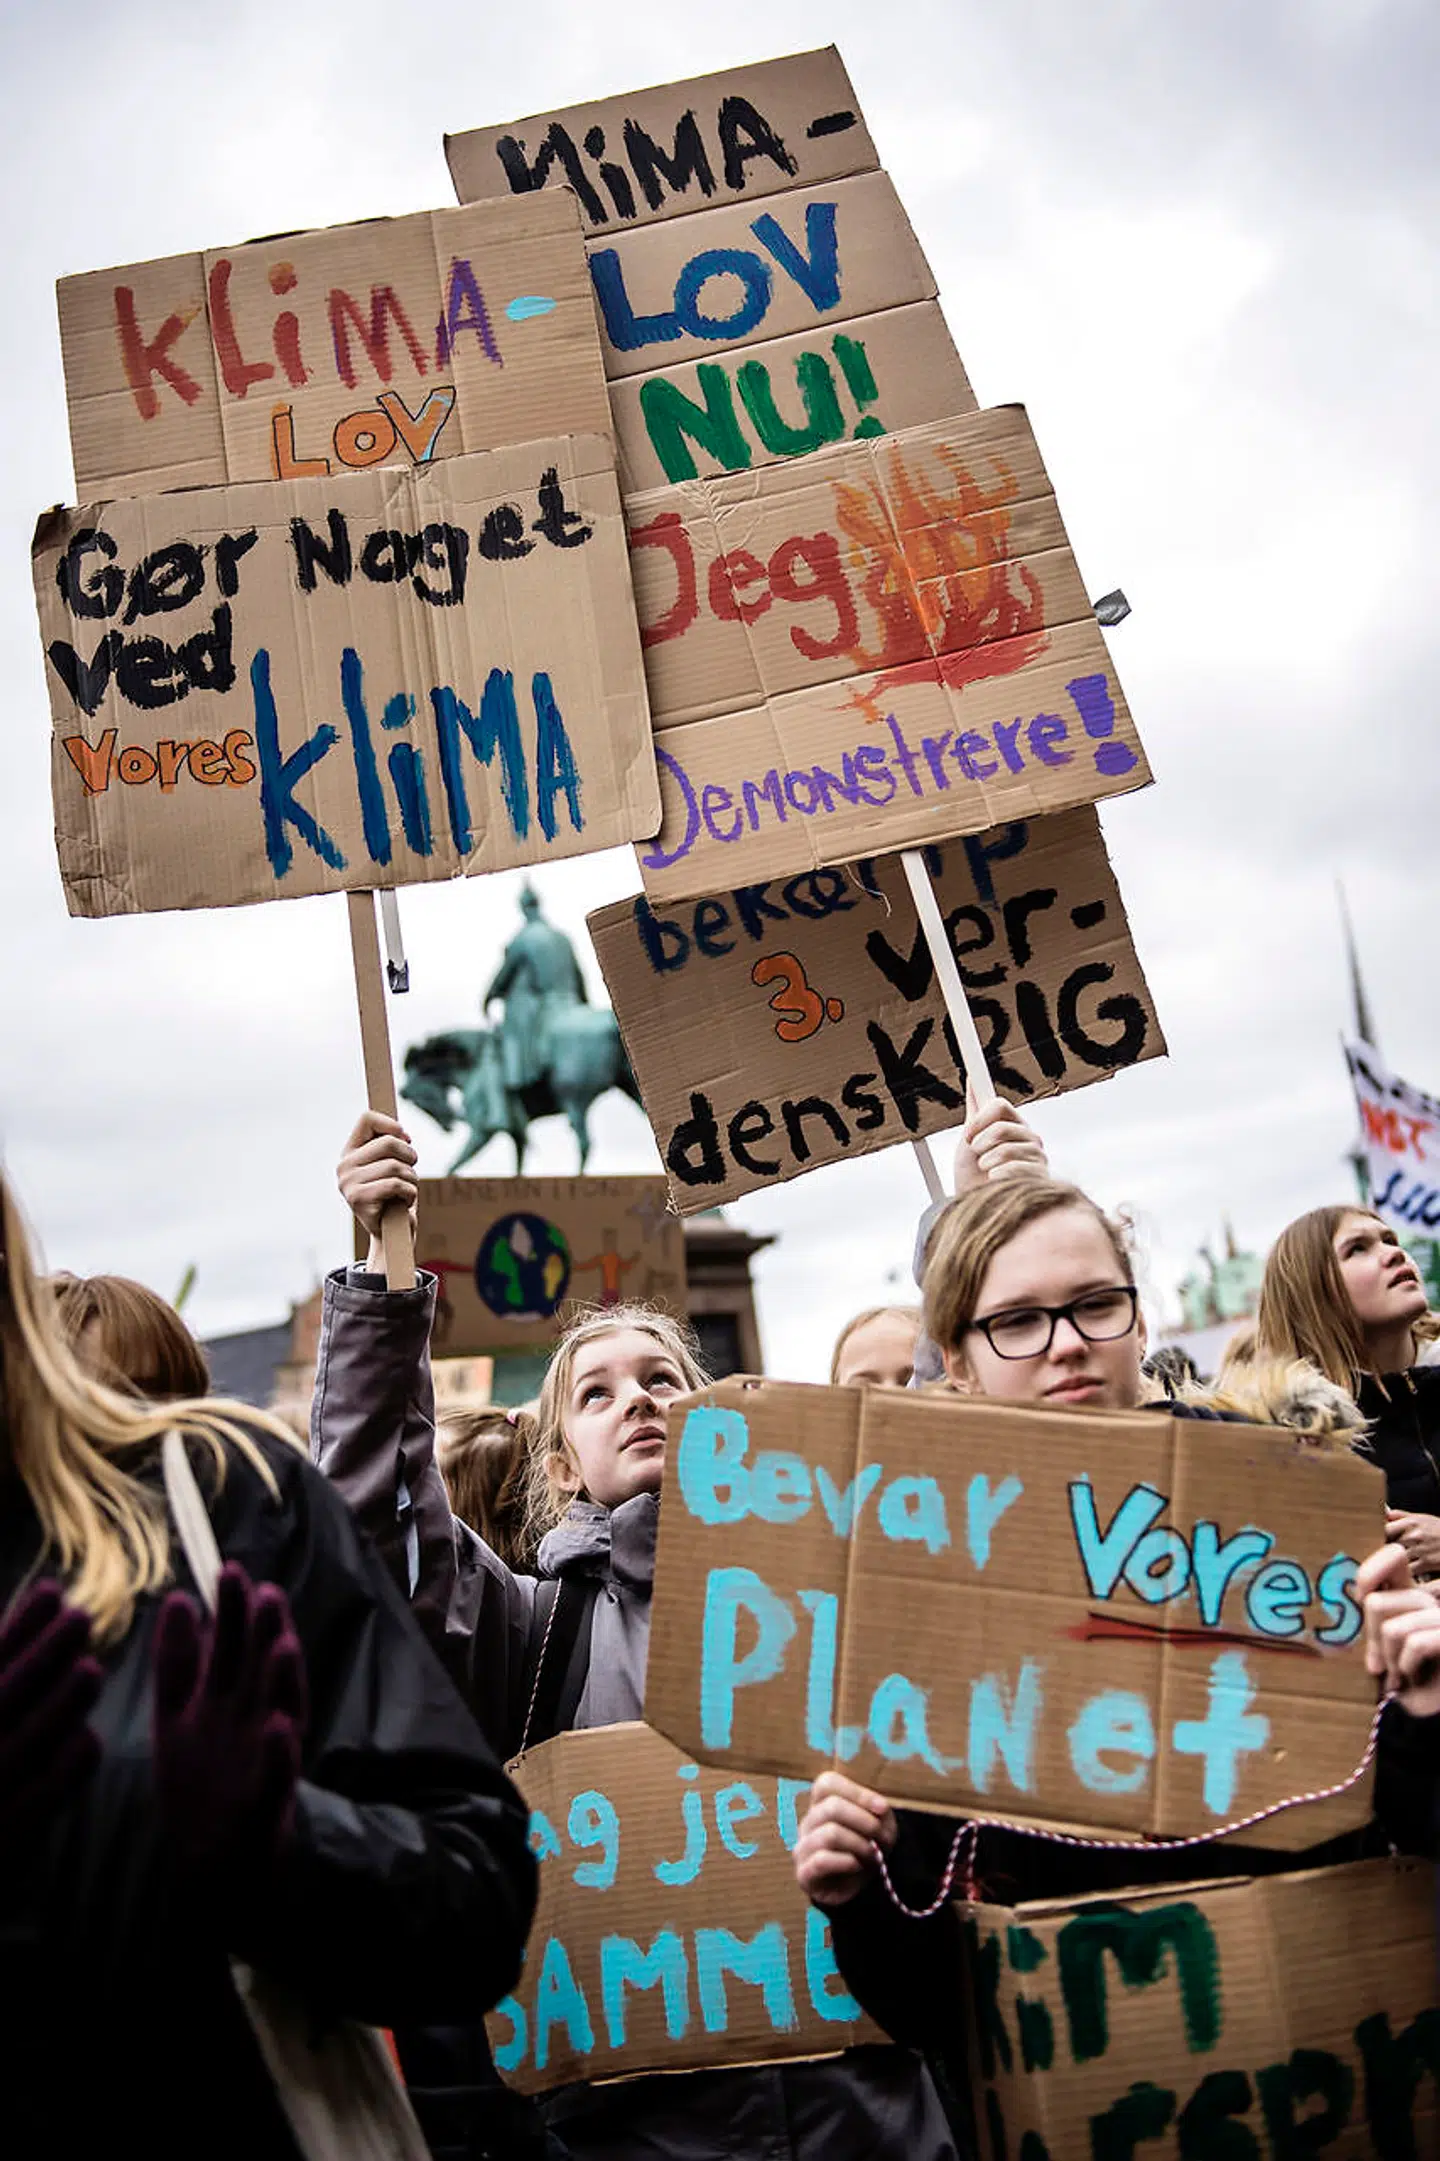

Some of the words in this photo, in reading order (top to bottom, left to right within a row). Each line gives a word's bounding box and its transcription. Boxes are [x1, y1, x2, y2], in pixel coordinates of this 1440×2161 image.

[588, 203, 839, 352] LOV
[270, 385, 457, 481] LOV
[640, 334, 887, 484] NU!
[289, 466, 595, 609] Noget
[630, 510, 860, 662] Jeg
[62, 728, 258, 798] Vores
[751, 952, 845, 1043] 3.
[678, 1403, 1024, 1570] Bevar
[1066, 1473, 1366, 1648] Vores
[527, 1789, 620, 1891] ag
